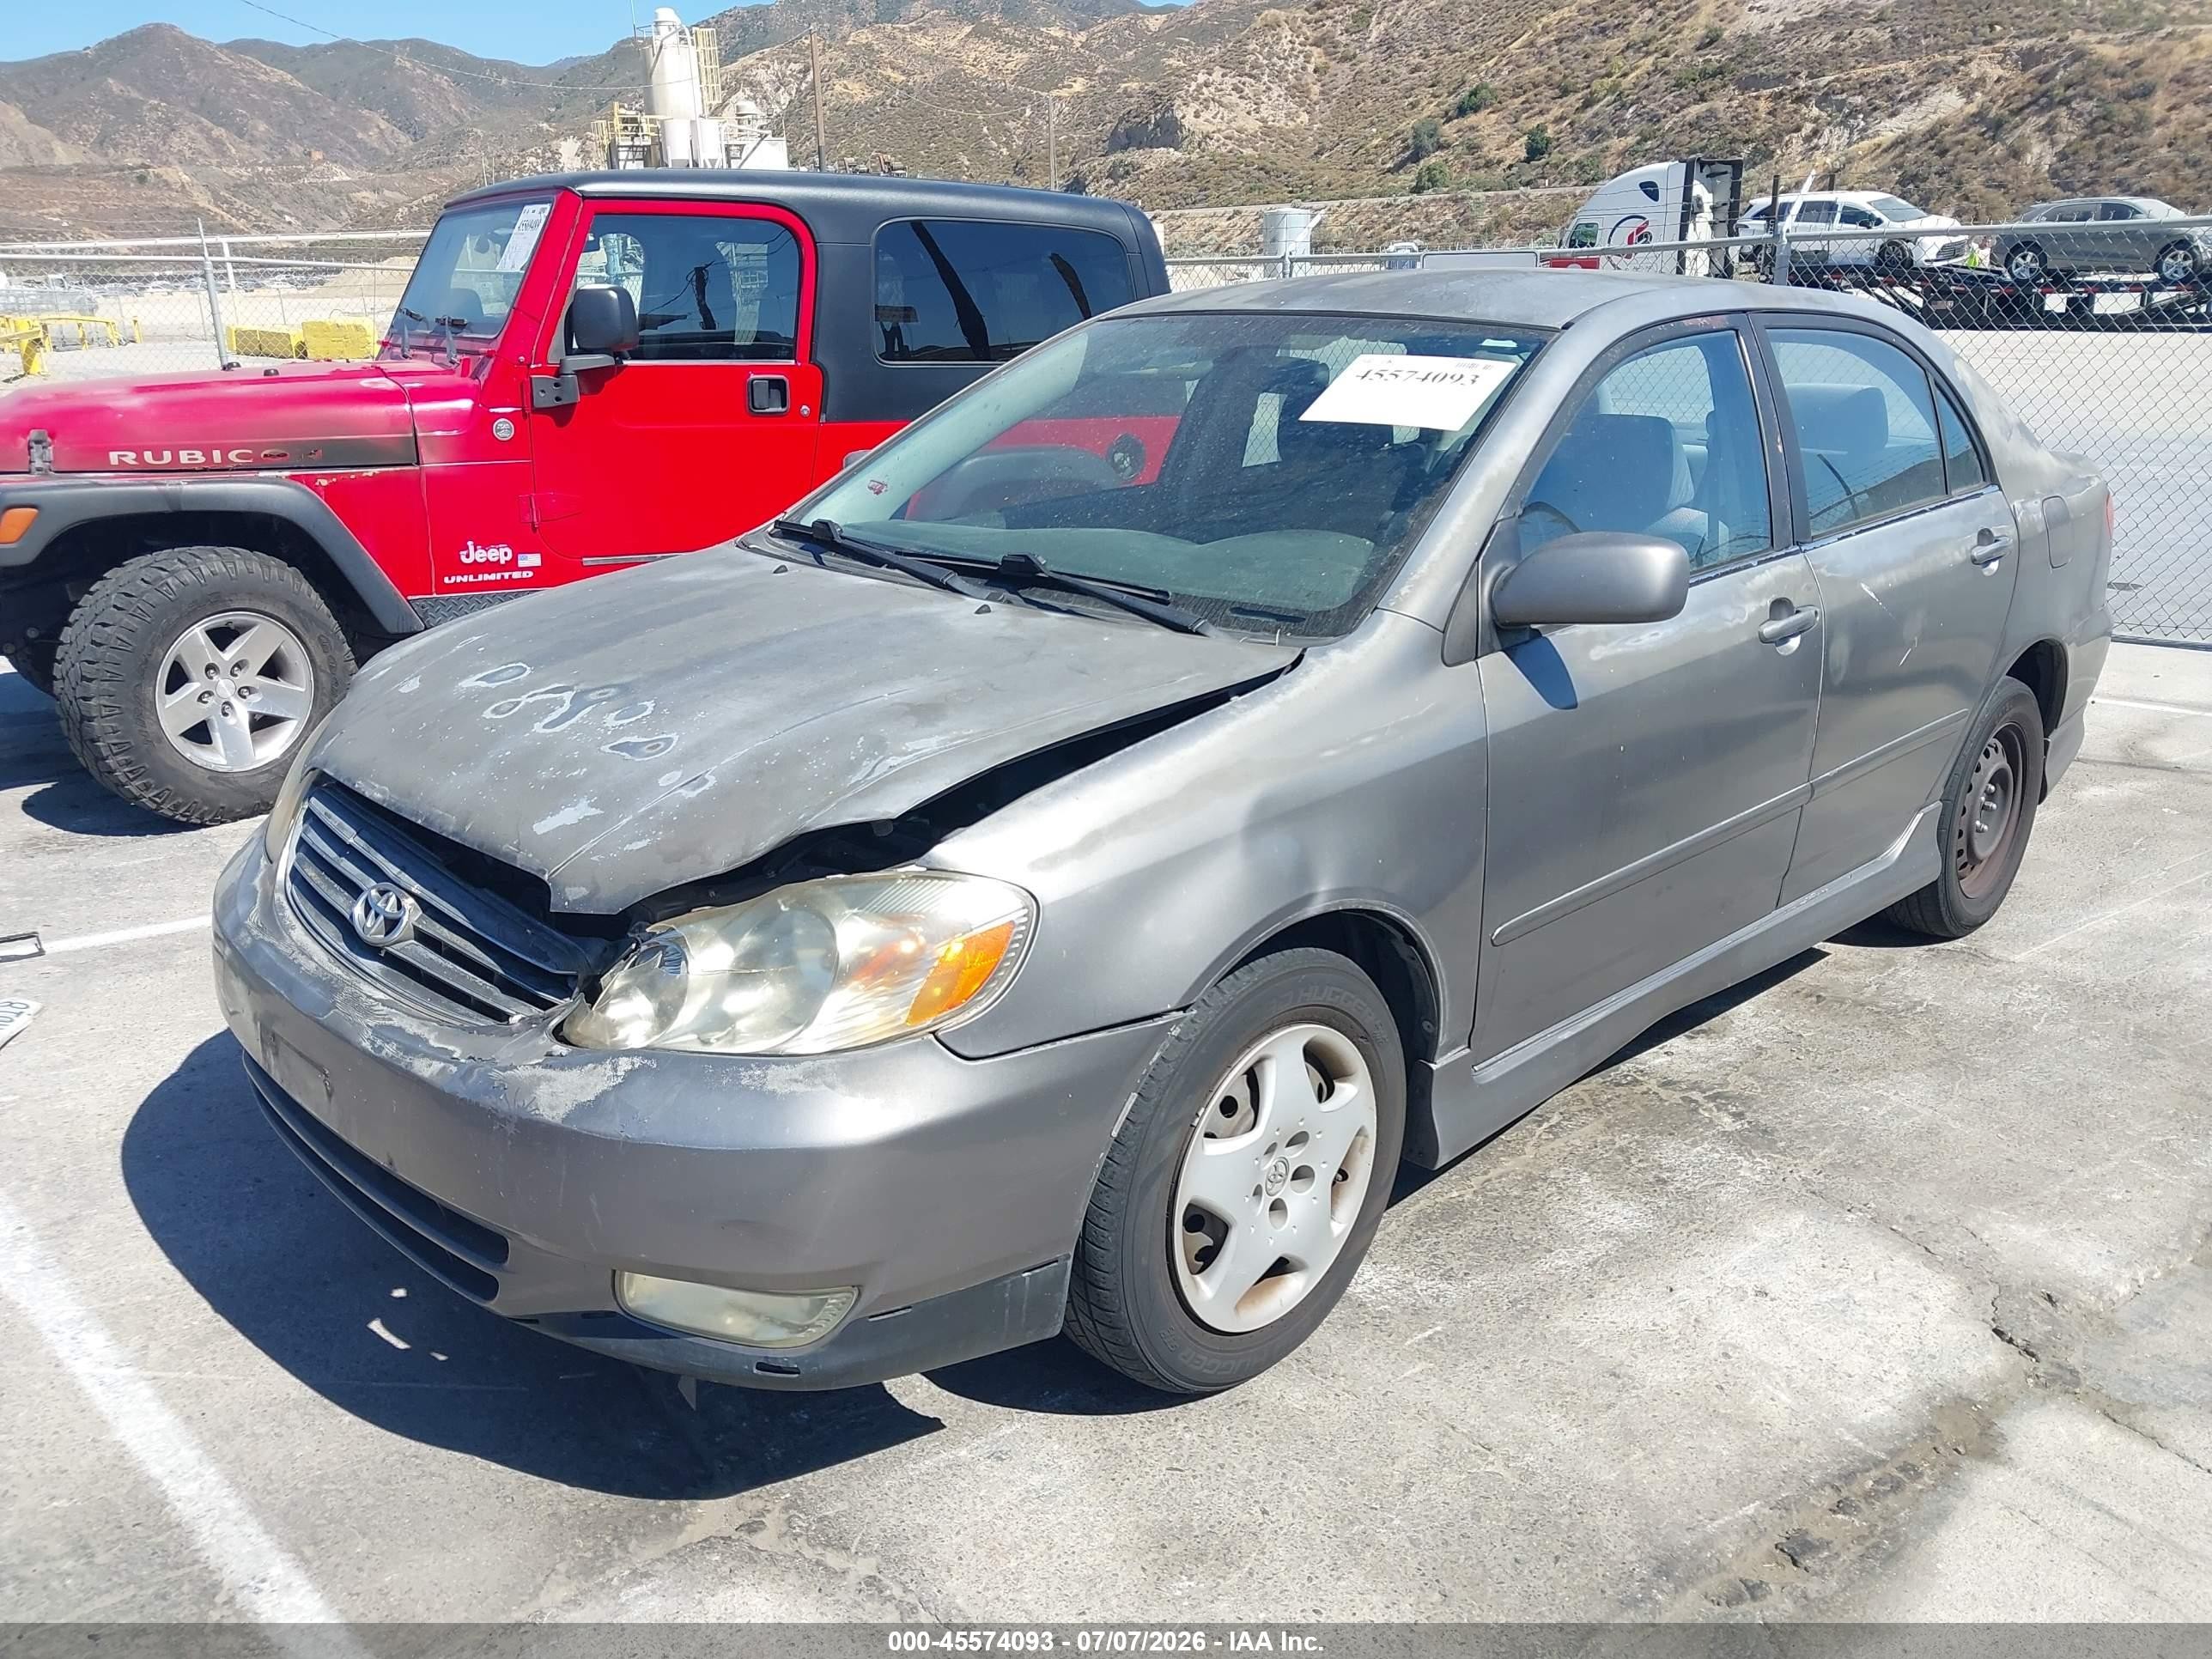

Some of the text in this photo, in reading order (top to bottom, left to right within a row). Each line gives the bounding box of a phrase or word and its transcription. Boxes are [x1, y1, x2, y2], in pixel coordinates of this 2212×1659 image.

[1356, 369, 1480, 386] 45574093
[109, 449, 322, 465] RUBICO
[459, 540, 513, 564] Jeep
[443, 570, 534, 584] UNLIMITED
